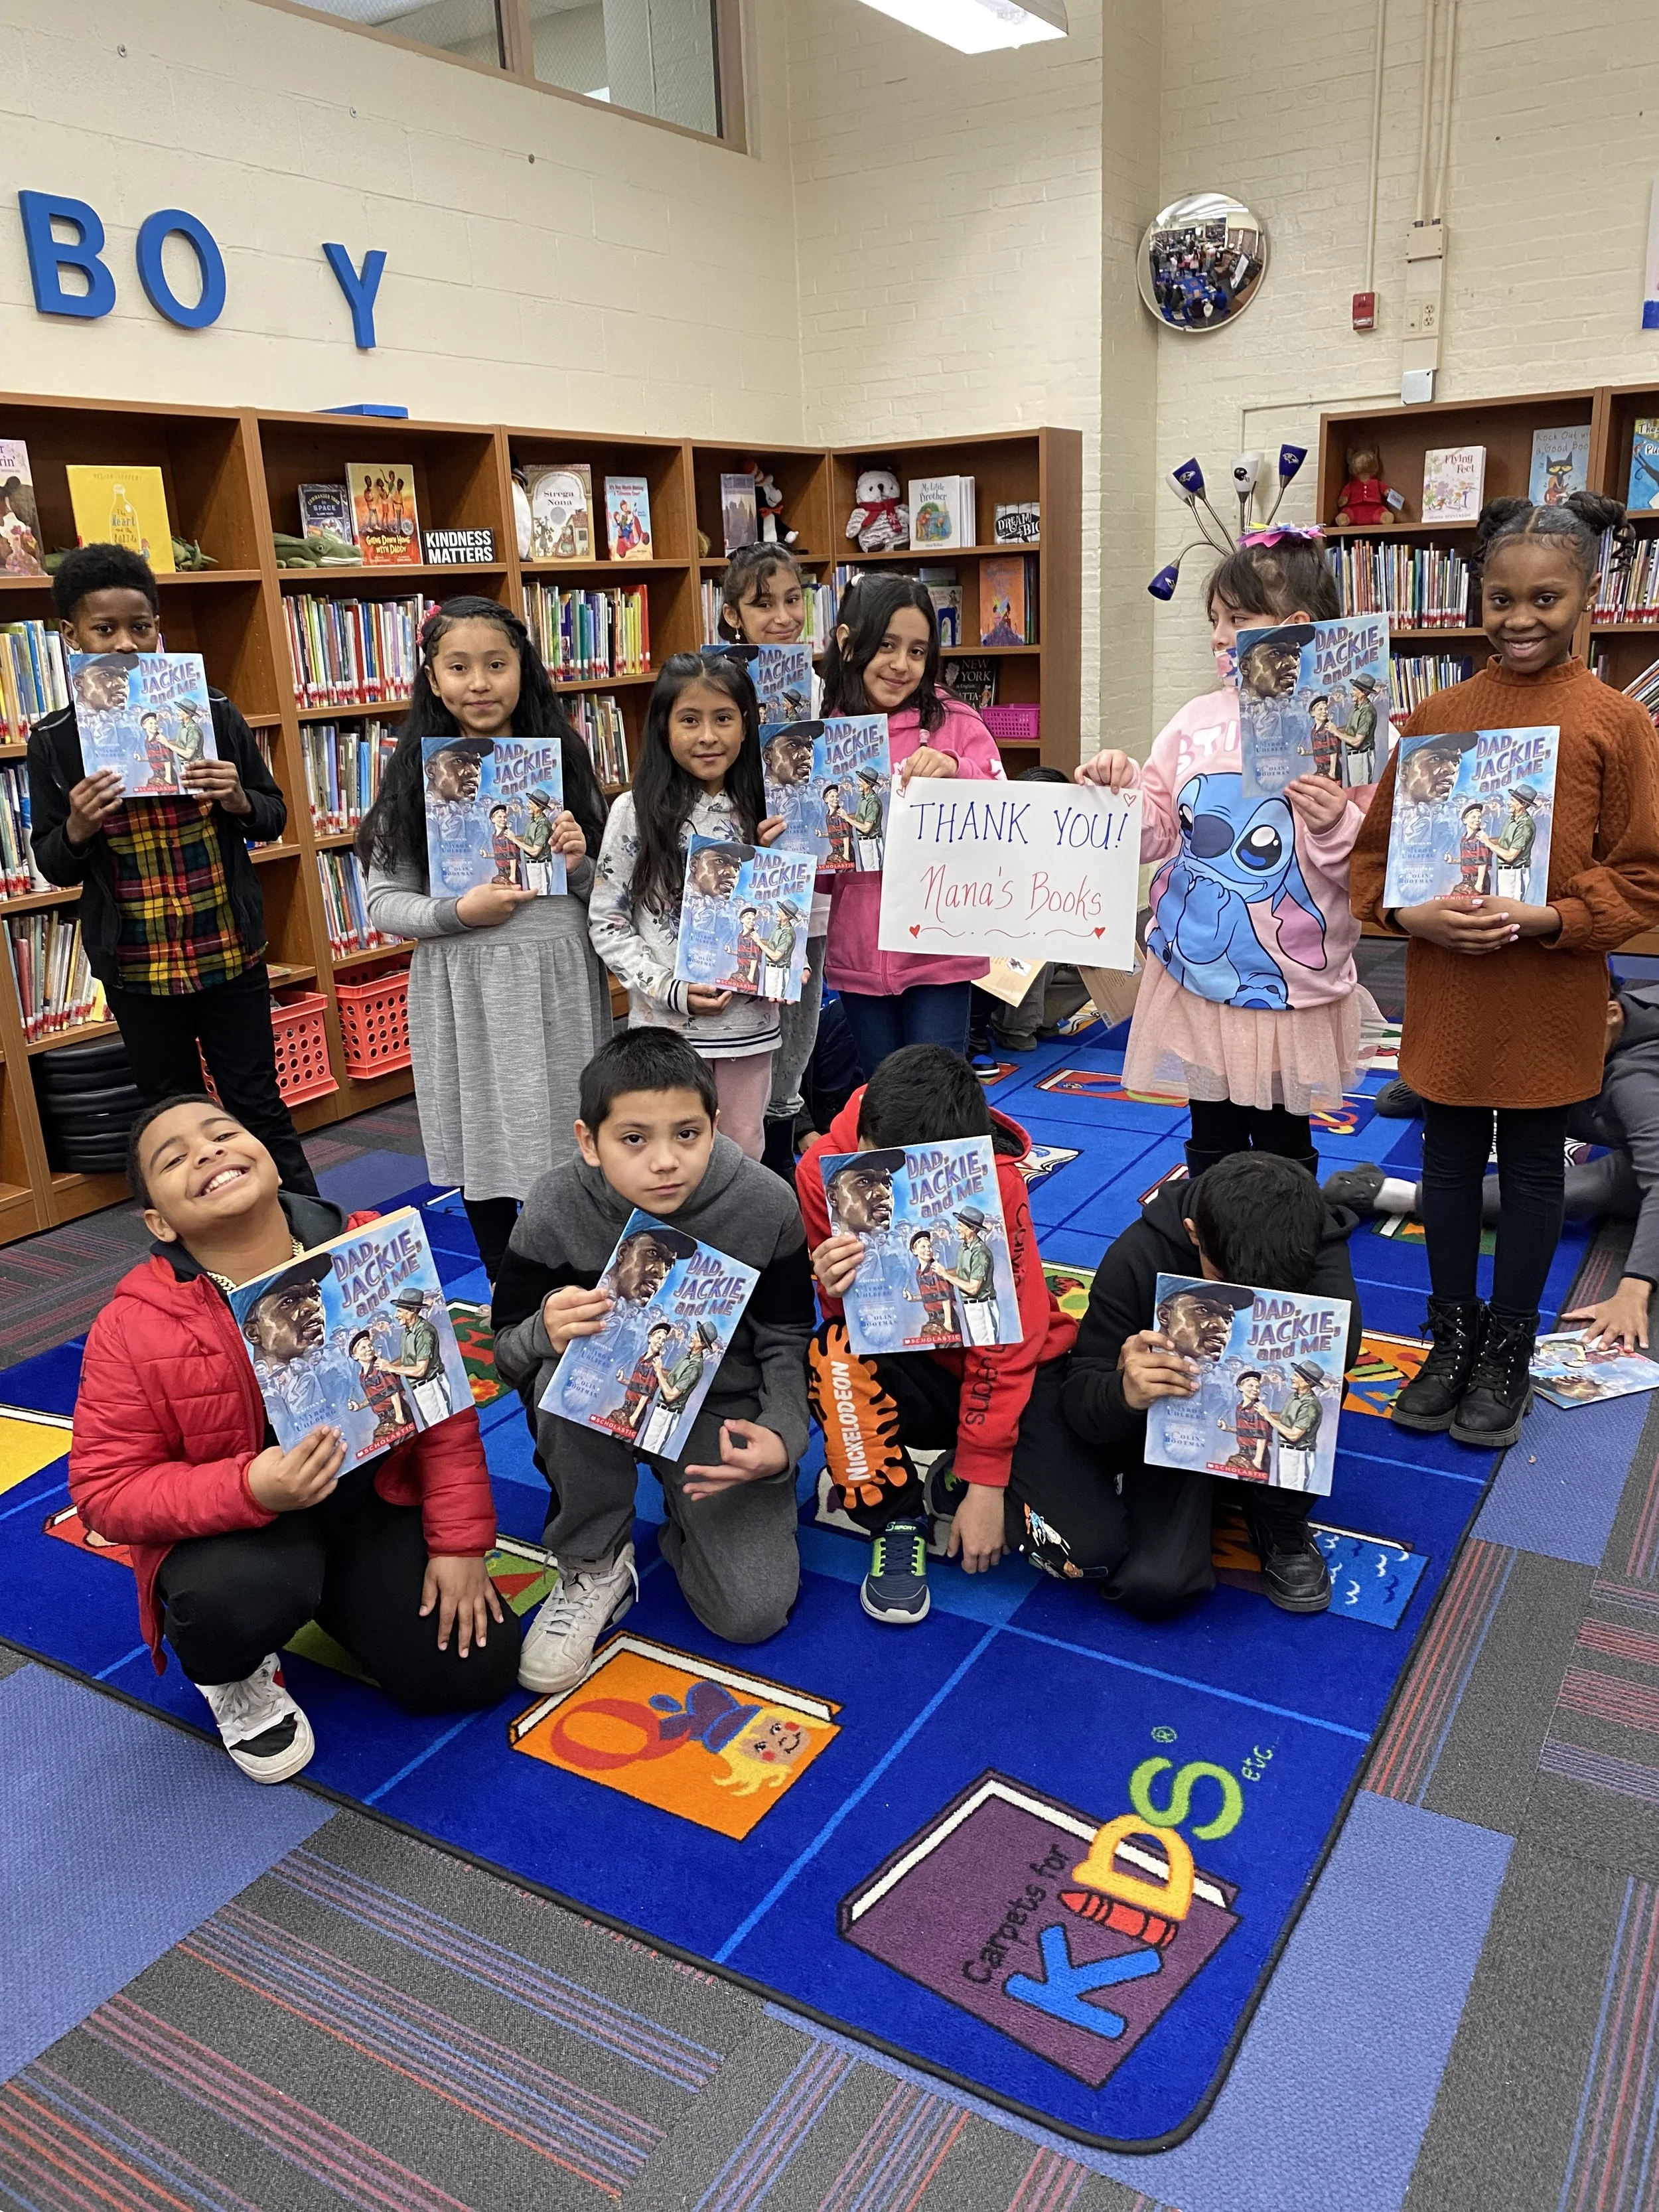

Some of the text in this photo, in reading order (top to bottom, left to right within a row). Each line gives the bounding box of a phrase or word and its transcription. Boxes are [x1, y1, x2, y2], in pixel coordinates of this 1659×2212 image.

[1445, 454, 1474, 465] Flying
[1545, 442, 1567, 453] Good
[1572, 440, 1589, 451] Boo
[1457, 465, 1475, 473] Feet
[920, 490, 947, 503] Brother
[922, 482, 929, 492] My
[111, 515, 135, 526] Heart
[997, 512, 1031, 532] DREAM
[425, 530, 492, 549] KINDNESS
[428, 546, 494, 564] MATTERS
[962, 658, 989, 669] NEW
[1314, 626, 1384, 674] JACKIE,
[141, 662, 201, 695] JACKIE,
[757, 652, 808, 685] JACKIE,
[962, 671, 991, 682] YORK
[1323, 646, 1379, 685] and ME
[150, 680, 197, 704] and ME
[762, 668, 804, 695] and ME
[824, 724, 883, 765] JACKIE,
[493, 747, 557, 784] JACKIE,
[832, 743, 880, 775] and ME
[1471, 736, 1551, 781] JACKIE,
[501, 768, 552, 795] and ME
[1479, 759, 1543, 792] and ME
[910, 801, 1128, 849] THANK YOU!
[749, 863, 810, 889] JACKIE,
[755, 881, 804, 901] and ME
[920, 864, 1102, 923] Nana's Books
[720, 980, 758, 991] SCHOLASTIC
[909, 1149, 989, 1205] JACKIE,
[920, 1175, 984, 1218] and ME
[341, 1228, 423, 1309] JACKIE,
[355, 1254, 421, 1318] and ME
[674, 1277, 746, 1304] JACKIE,
[674, 1299, 737, 1317] and ME
[910, 1333, 961, 1344] SCHOLASTIC
[1248, 1311, 1341, 1346] JACKIE,
[1256, 1335, 1332, 1361] and ME
[595, 1416, 637, 1438] SCHOLASTIC
[831, 1361, 871, 1481] NICKELODEON
[363, 1424, 415, 1455] SCHOLASTIC
[1215, 1464, 1268, 1479] SCHOLASTIC
[1003, 1756, 1245, 2041] KIDS
[962, 1844, 1070, 1984] Carpets for
